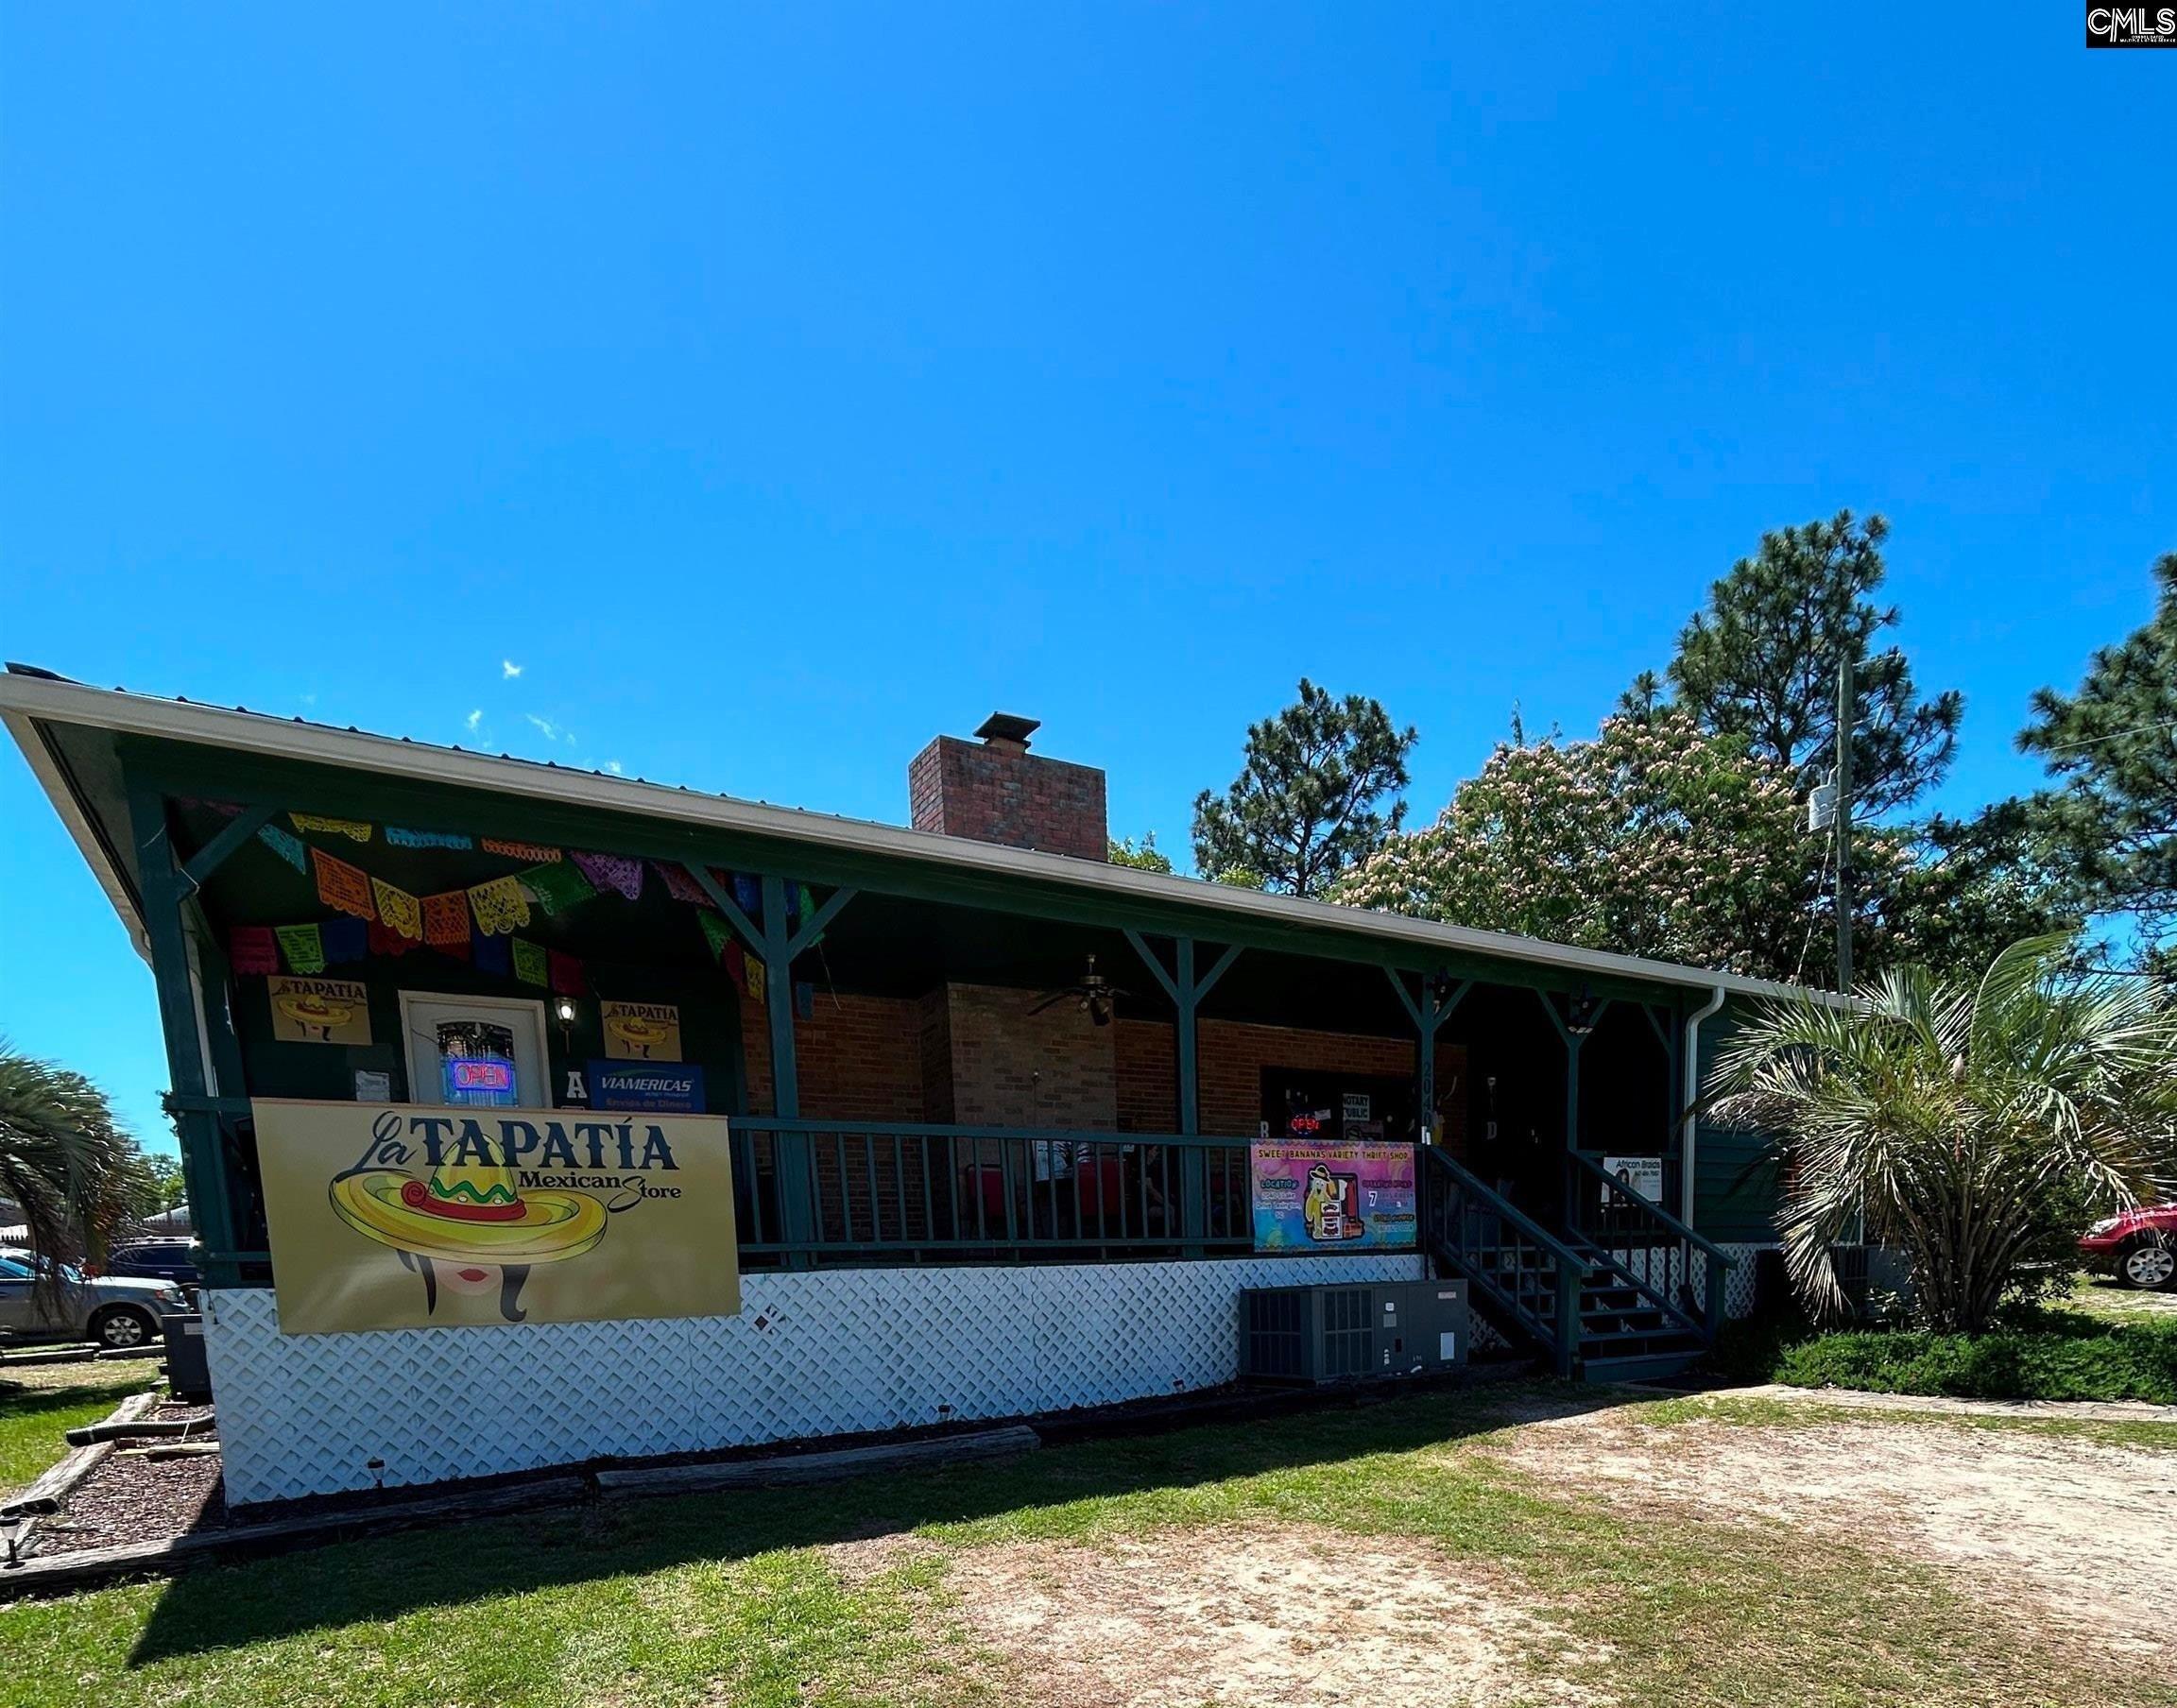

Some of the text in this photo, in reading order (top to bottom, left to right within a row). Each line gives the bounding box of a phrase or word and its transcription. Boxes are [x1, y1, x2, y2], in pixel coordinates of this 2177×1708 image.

[456, 1064, 506, 1085] OPEN
[567, 1071, 588, 1099] A
[601, 1076, 692, 1092] VIAMERICAS
[335, 1110, 680, 1183] La TAPATÍA
[1290, 1149, 1326, 1159] BANANAS
[1328, 1150, 1360, 1160] VARIETY
[1390, 1152, 1408, 1161] SHOP
[1616, 1160, 1640, 1169] African
[519, 1170, 682, 1214] Mexican Store
